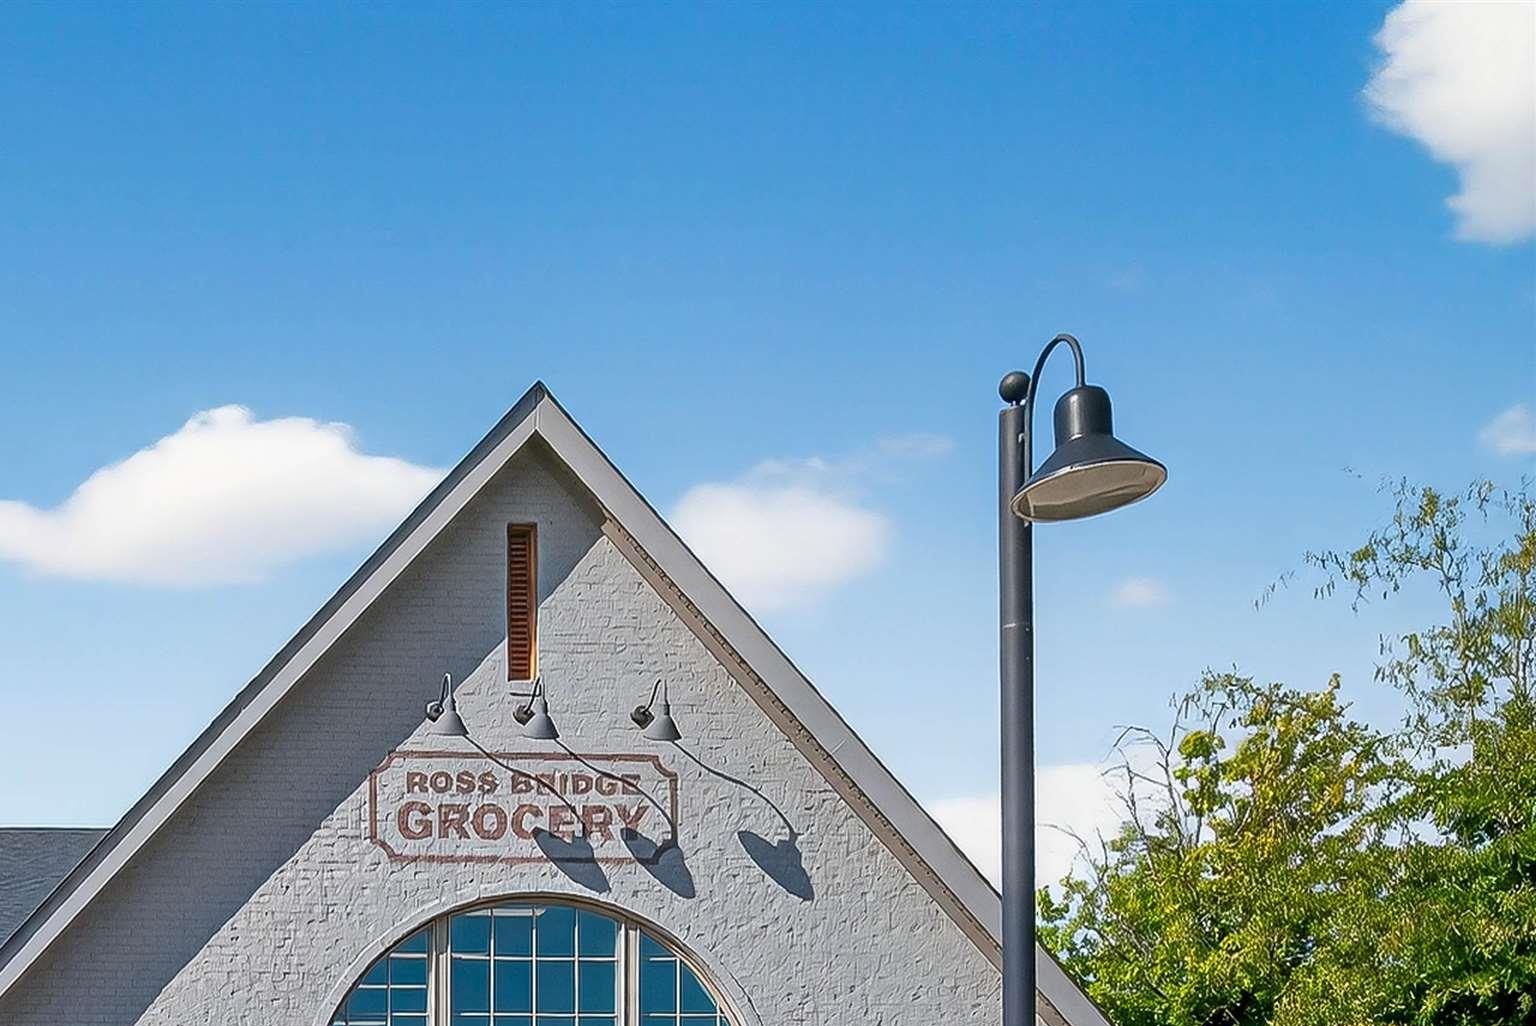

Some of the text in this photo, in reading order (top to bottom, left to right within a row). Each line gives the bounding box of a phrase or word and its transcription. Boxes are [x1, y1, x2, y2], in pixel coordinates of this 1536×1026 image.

[406, 770, 642, 796] ROSS BRIDGE
[397, 800, 650, 841] GROCERY
